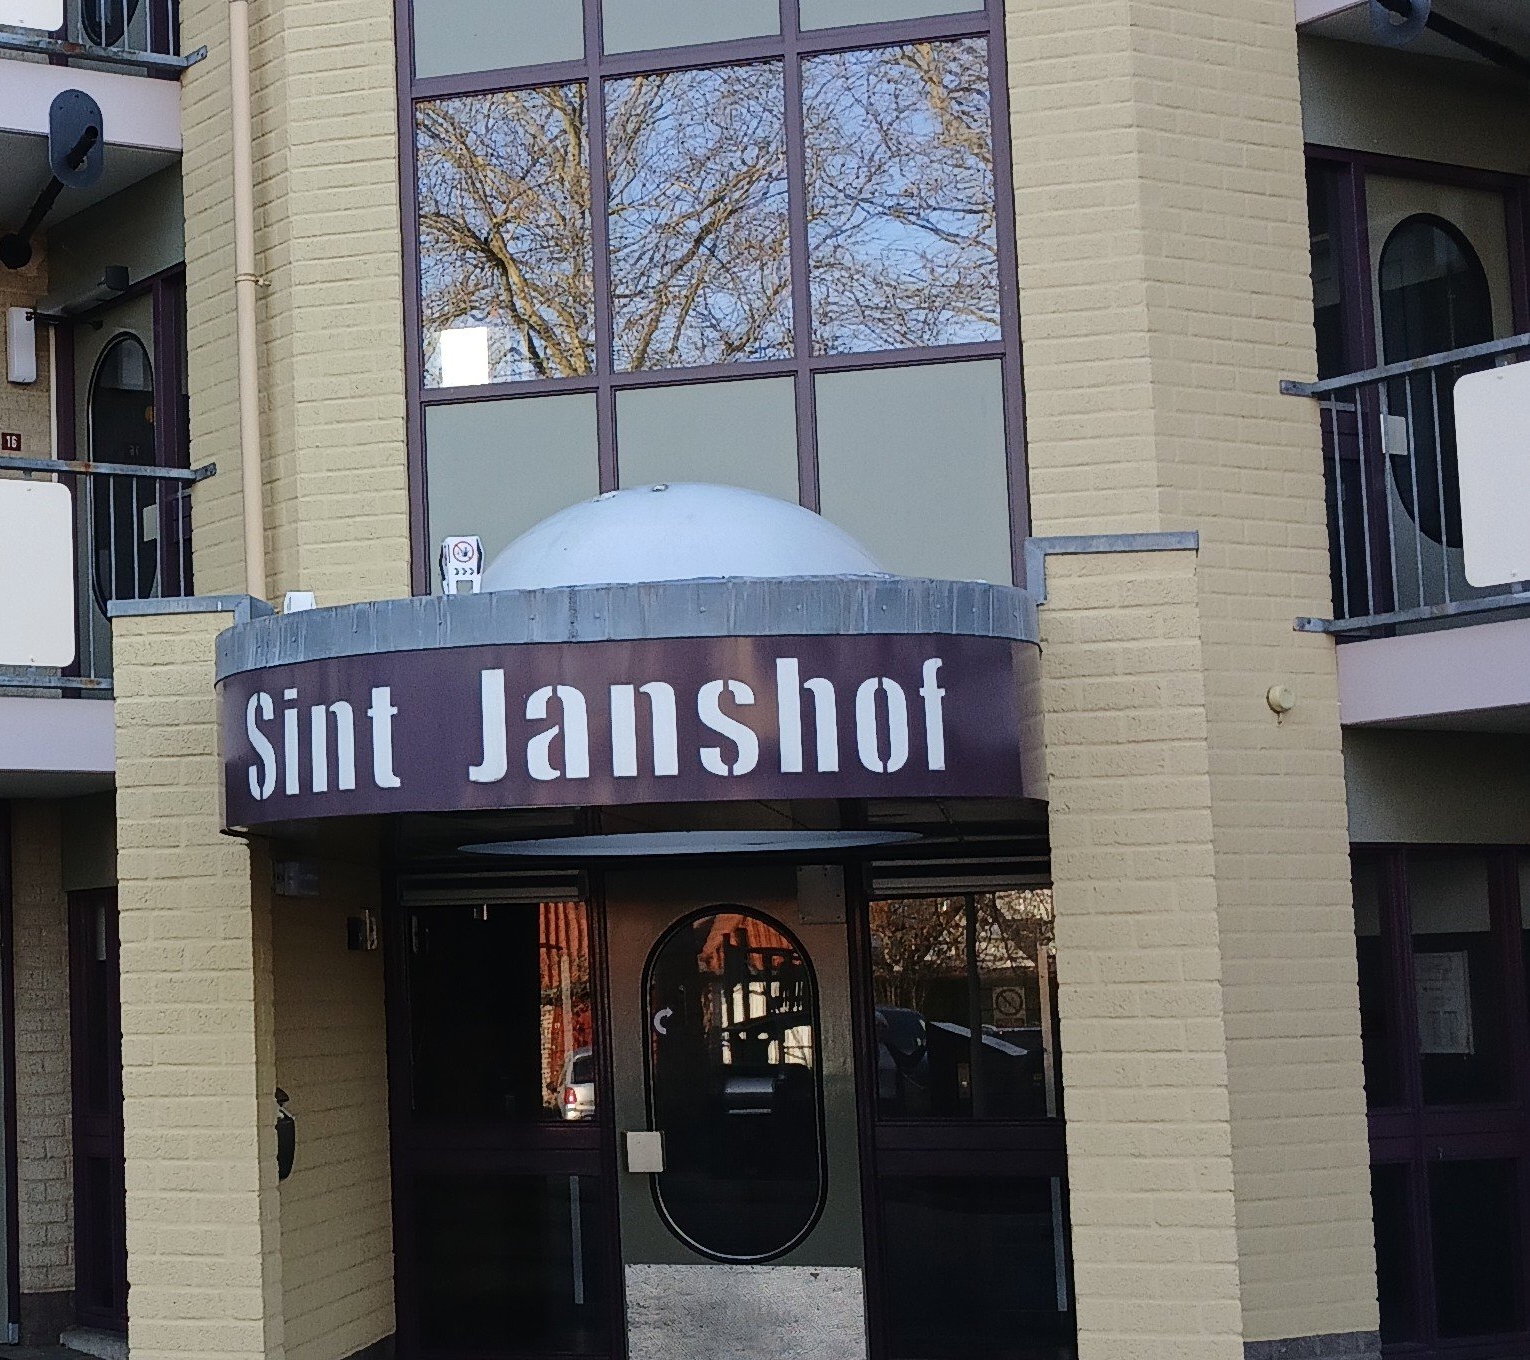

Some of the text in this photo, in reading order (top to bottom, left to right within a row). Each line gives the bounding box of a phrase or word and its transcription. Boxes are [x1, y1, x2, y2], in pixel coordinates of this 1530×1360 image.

[6, 435, 18, 448] 16
[247, 658, 945, 799] Sint Janshof
